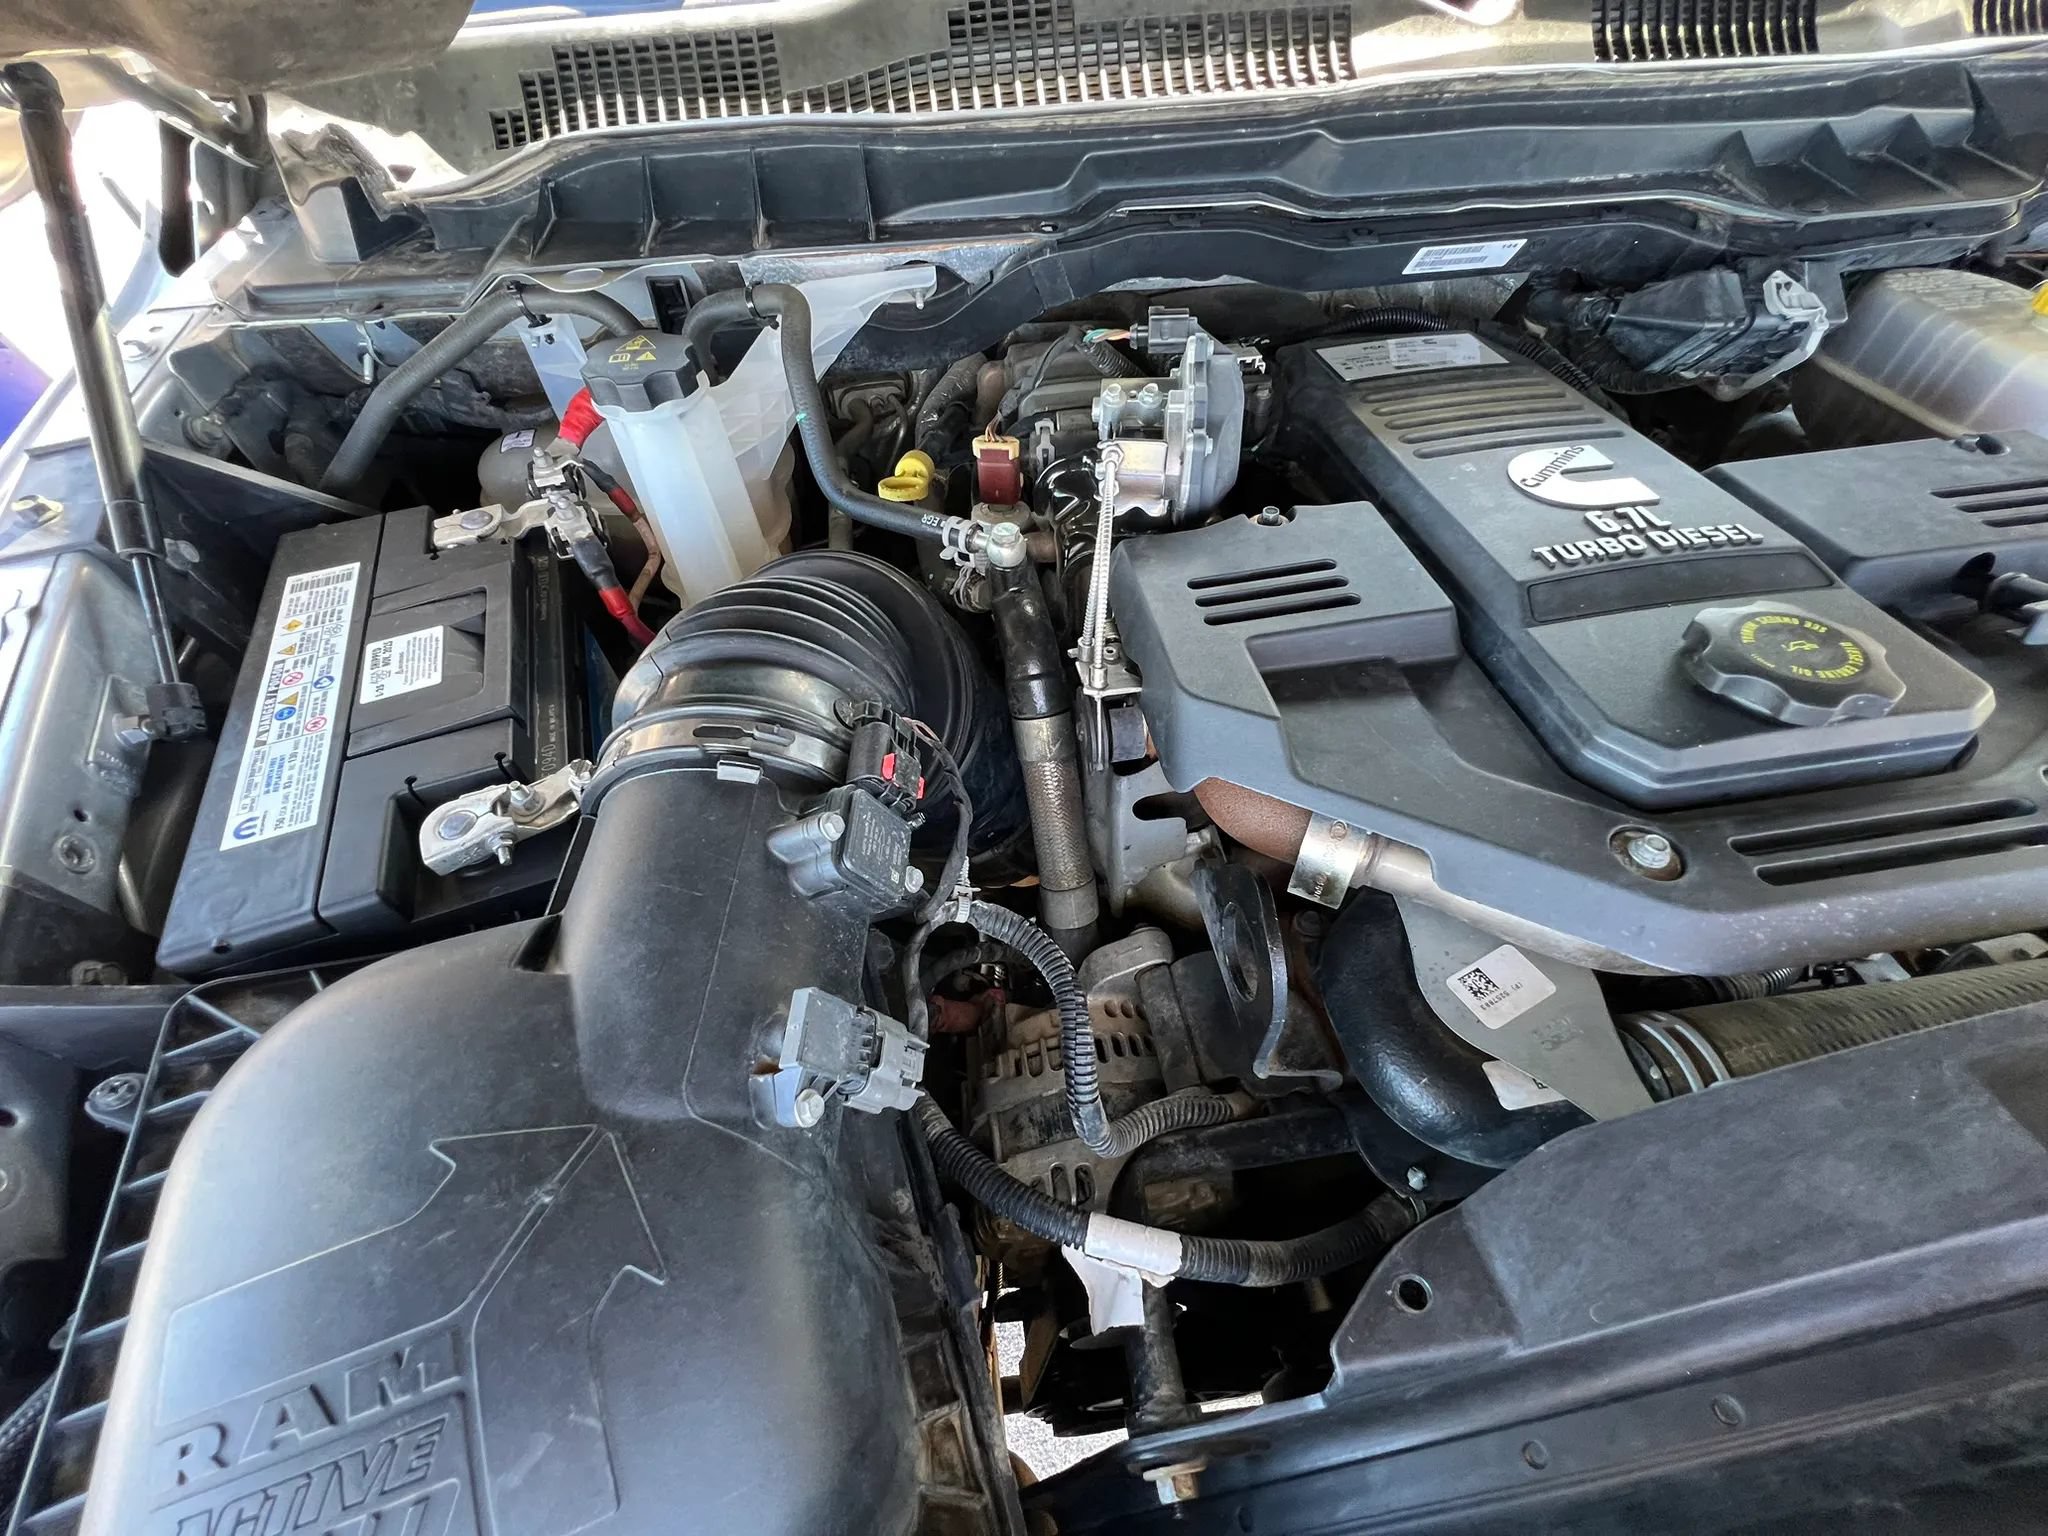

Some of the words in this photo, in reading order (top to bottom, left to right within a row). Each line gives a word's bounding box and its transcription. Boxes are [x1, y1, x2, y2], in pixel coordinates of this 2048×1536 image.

[1519, 444, 1585, 488] Cummins
[1583, 505, 1673, 536] 6.7L
[1532, 533, 1649, 568] TURBO
[1647, 523, 1764, 554] DIESEL
[1790, 664, 1813, 677] OIL
[258, 697, 276, 731] DANGER
[268, 663, 283, 690] POISON
[272, 754, 286, 792] REPLACEMENT
[158, 1325, 467, 1492] RAM
